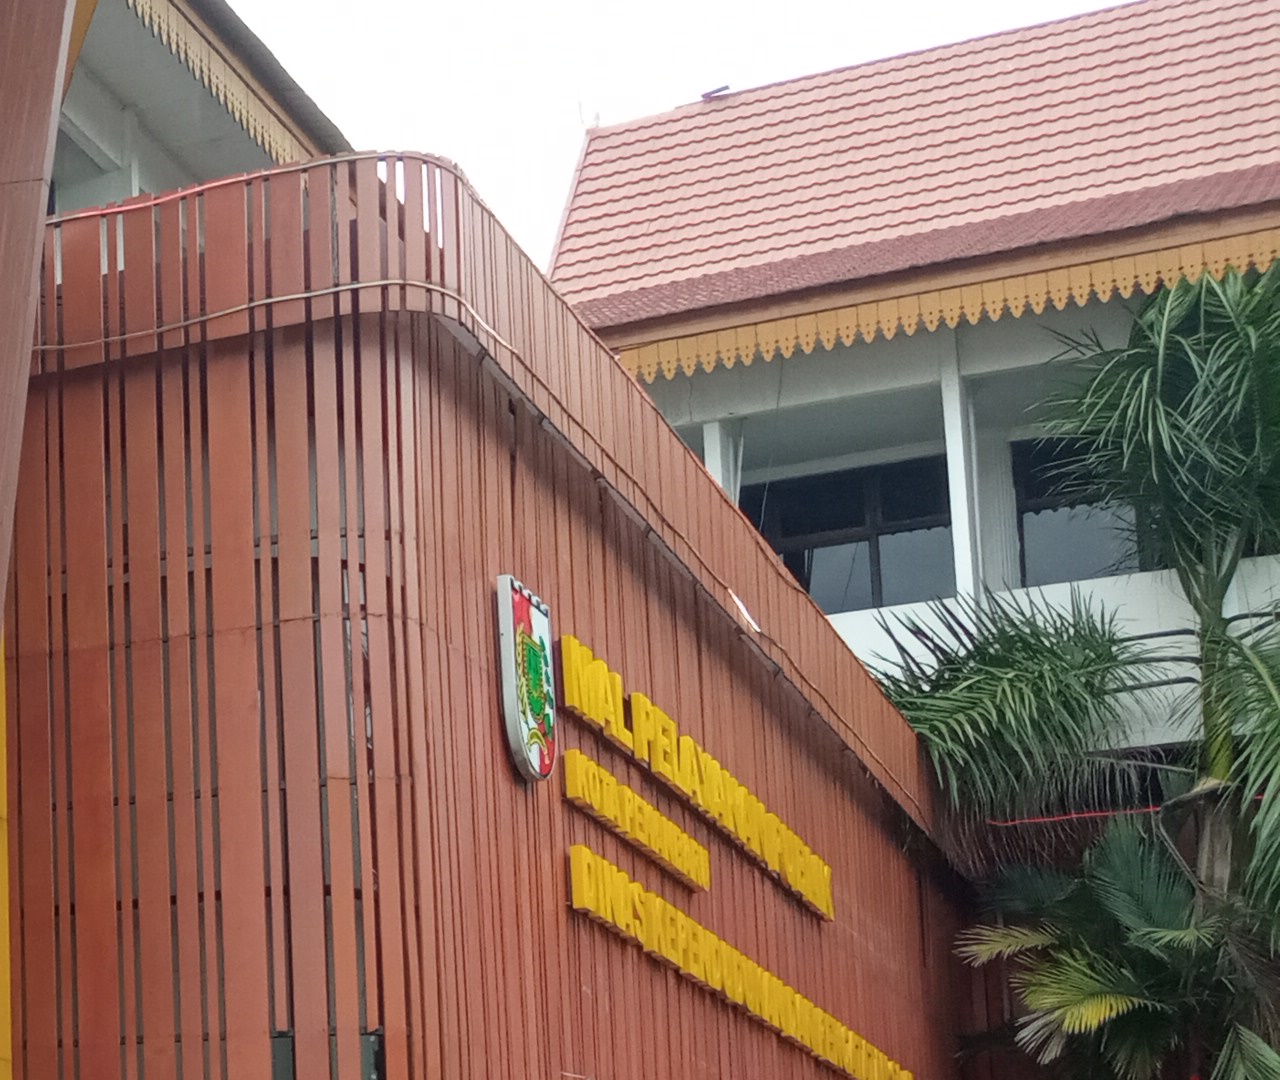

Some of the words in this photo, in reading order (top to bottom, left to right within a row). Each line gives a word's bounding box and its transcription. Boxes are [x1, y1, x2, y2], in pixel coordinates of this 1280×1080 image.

[561, 634, 634, 753] MAL
[564, 748, 619, 829] KOTA
[570, 843, 645, 948] DINAS
